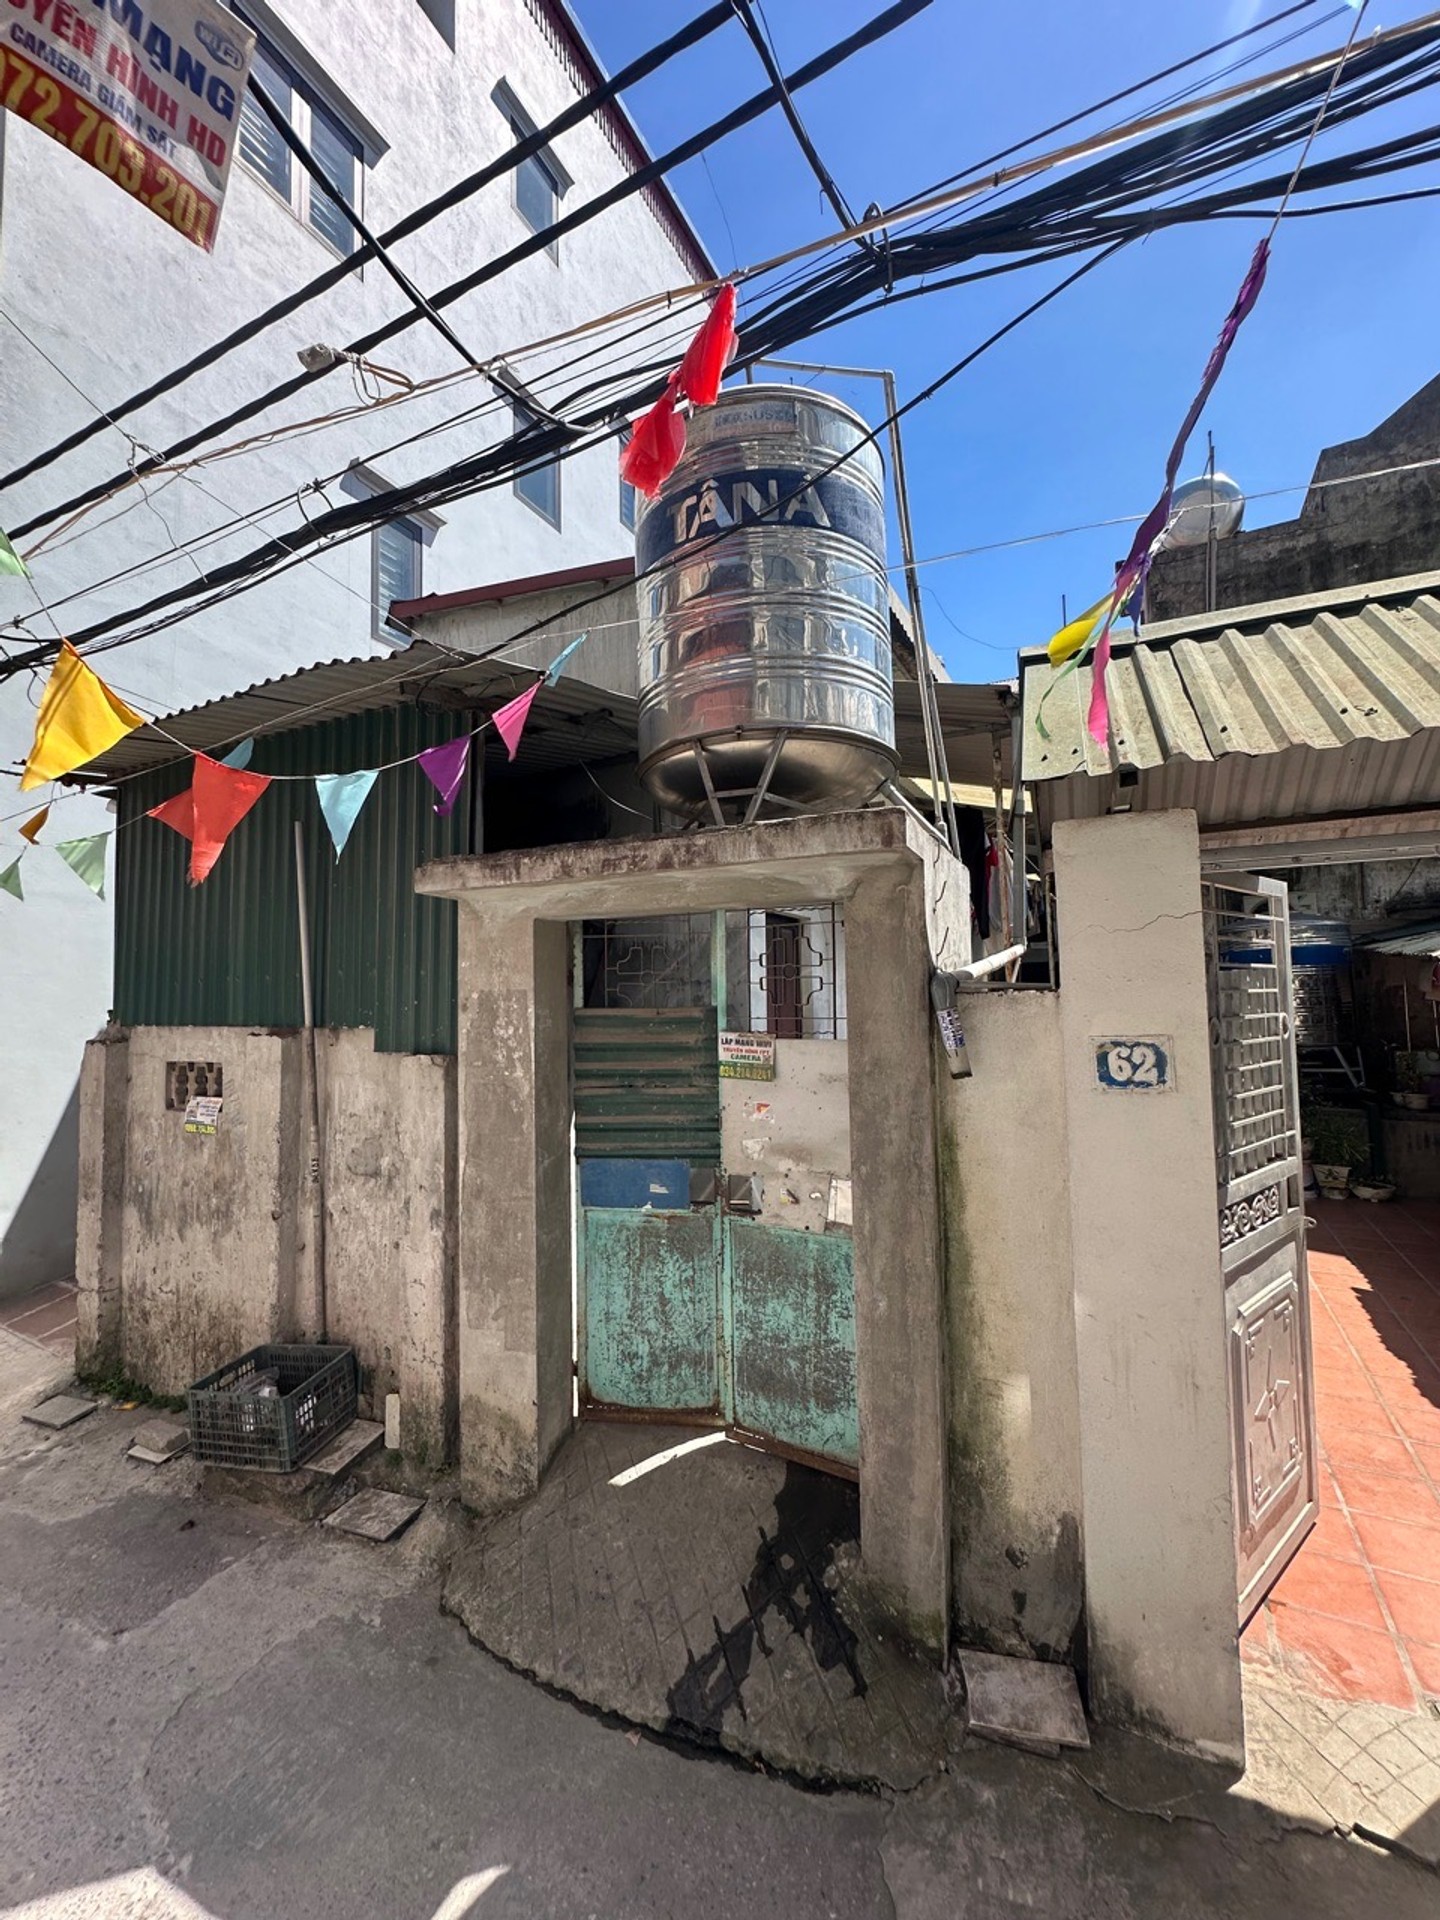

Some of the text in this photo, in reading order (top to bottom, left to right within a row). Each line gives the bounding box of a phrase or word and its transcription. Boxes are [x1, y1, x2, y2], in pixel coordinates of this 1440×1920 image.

[7, 0, 227, 168] YỀN HÌNH HD
[10, 22, 92, 94] CAMERA
[0, 46, 212, 246] 72.703.201
[730, 1053, 762, 1061] CAMERA
[1107, 1045, 1159, 1083] 62
